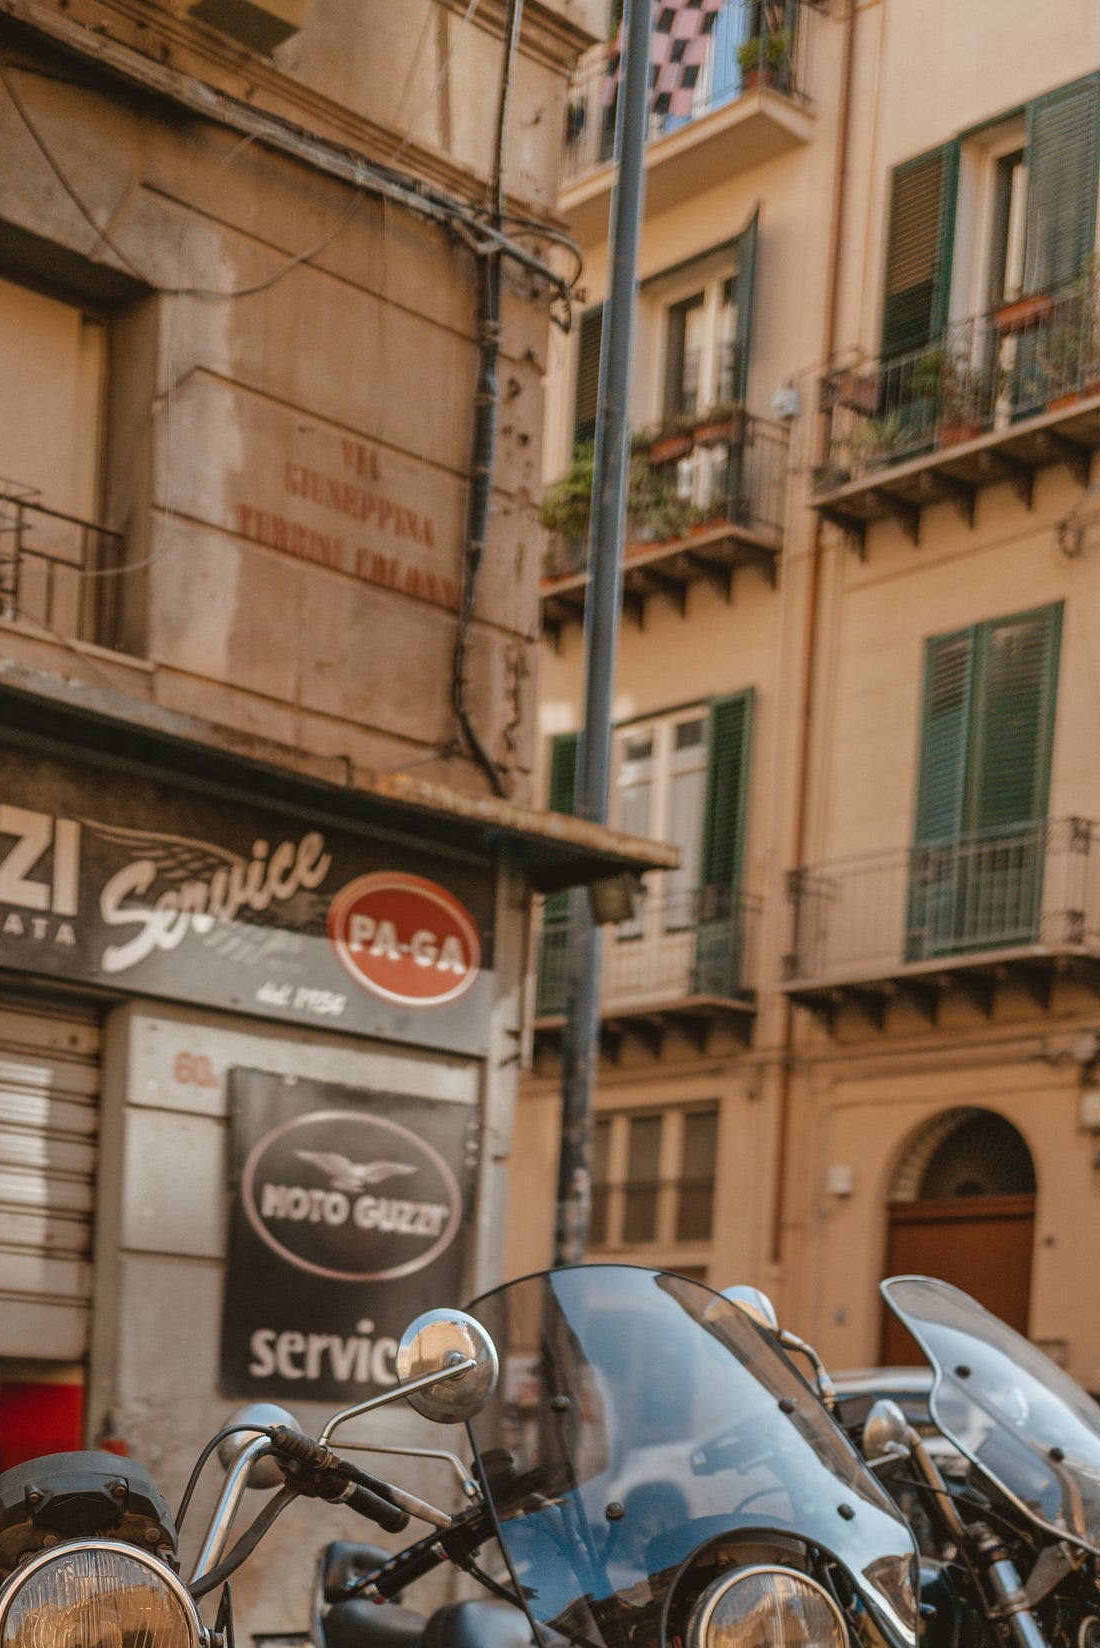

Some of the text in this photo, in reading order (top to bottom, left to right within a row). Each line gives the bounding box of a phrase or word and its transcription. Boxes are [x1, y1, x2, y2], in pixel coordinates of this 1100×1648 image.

[100, 831, 332, 973] Service
[350, 914, 466, 975] PA-GA
[262, 1182, 450, 1238] MOTO GUZZI
[250, 1318, 399, 1385] servic
